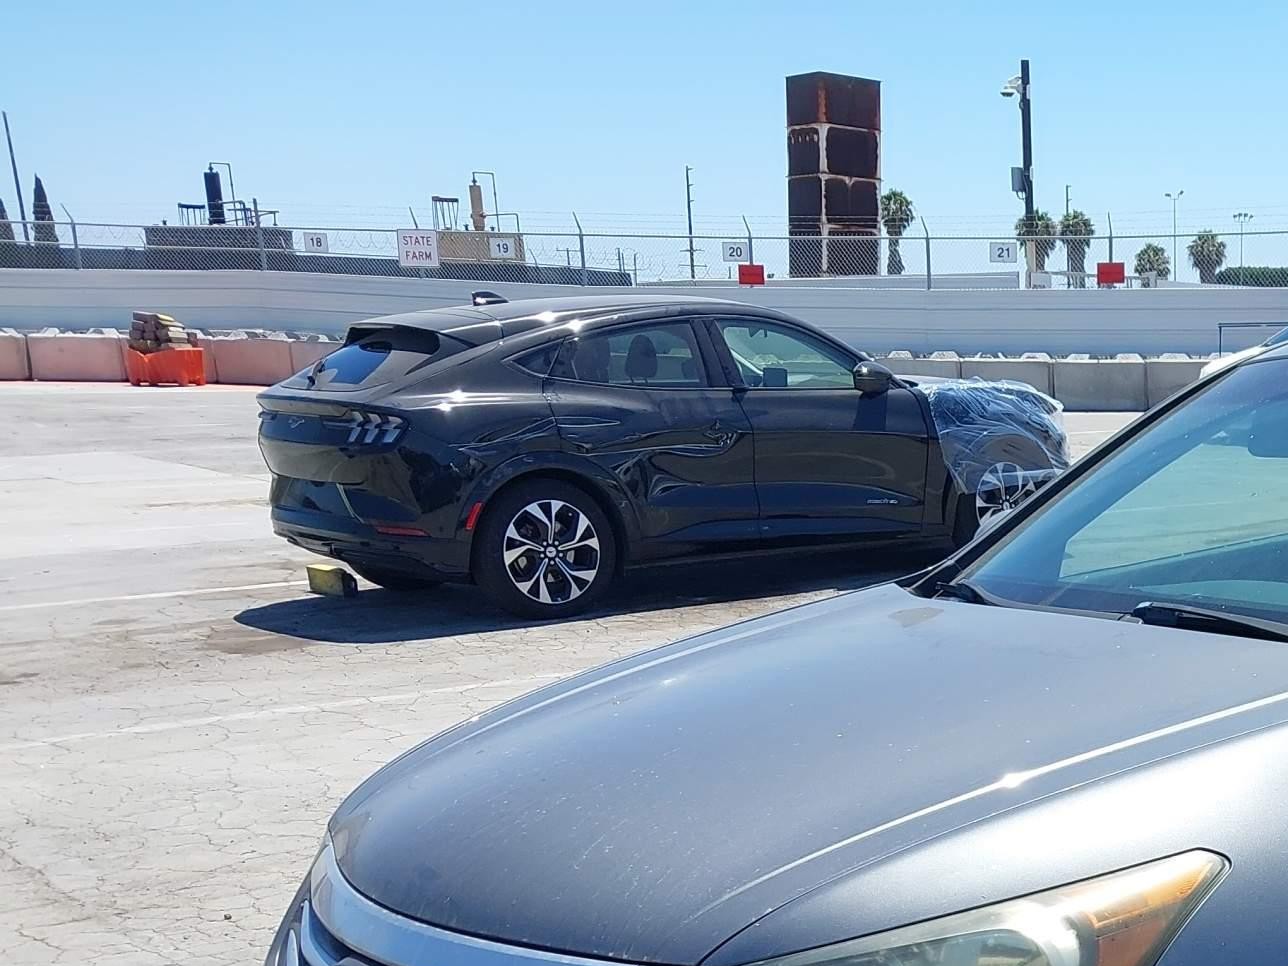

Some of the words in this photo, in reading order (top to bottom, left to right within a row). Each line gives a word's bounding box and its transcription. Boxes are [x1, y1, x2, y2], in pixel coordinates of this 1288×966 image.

[309, 237, 322, 248] 18
[402, 235, 432, 246] STATE
[496, 242, 509, 254] 19
[729, 246, 742, 257] 20
[997, 247, 1010, 258] 21
[405, 250, 432, 261] FARM
